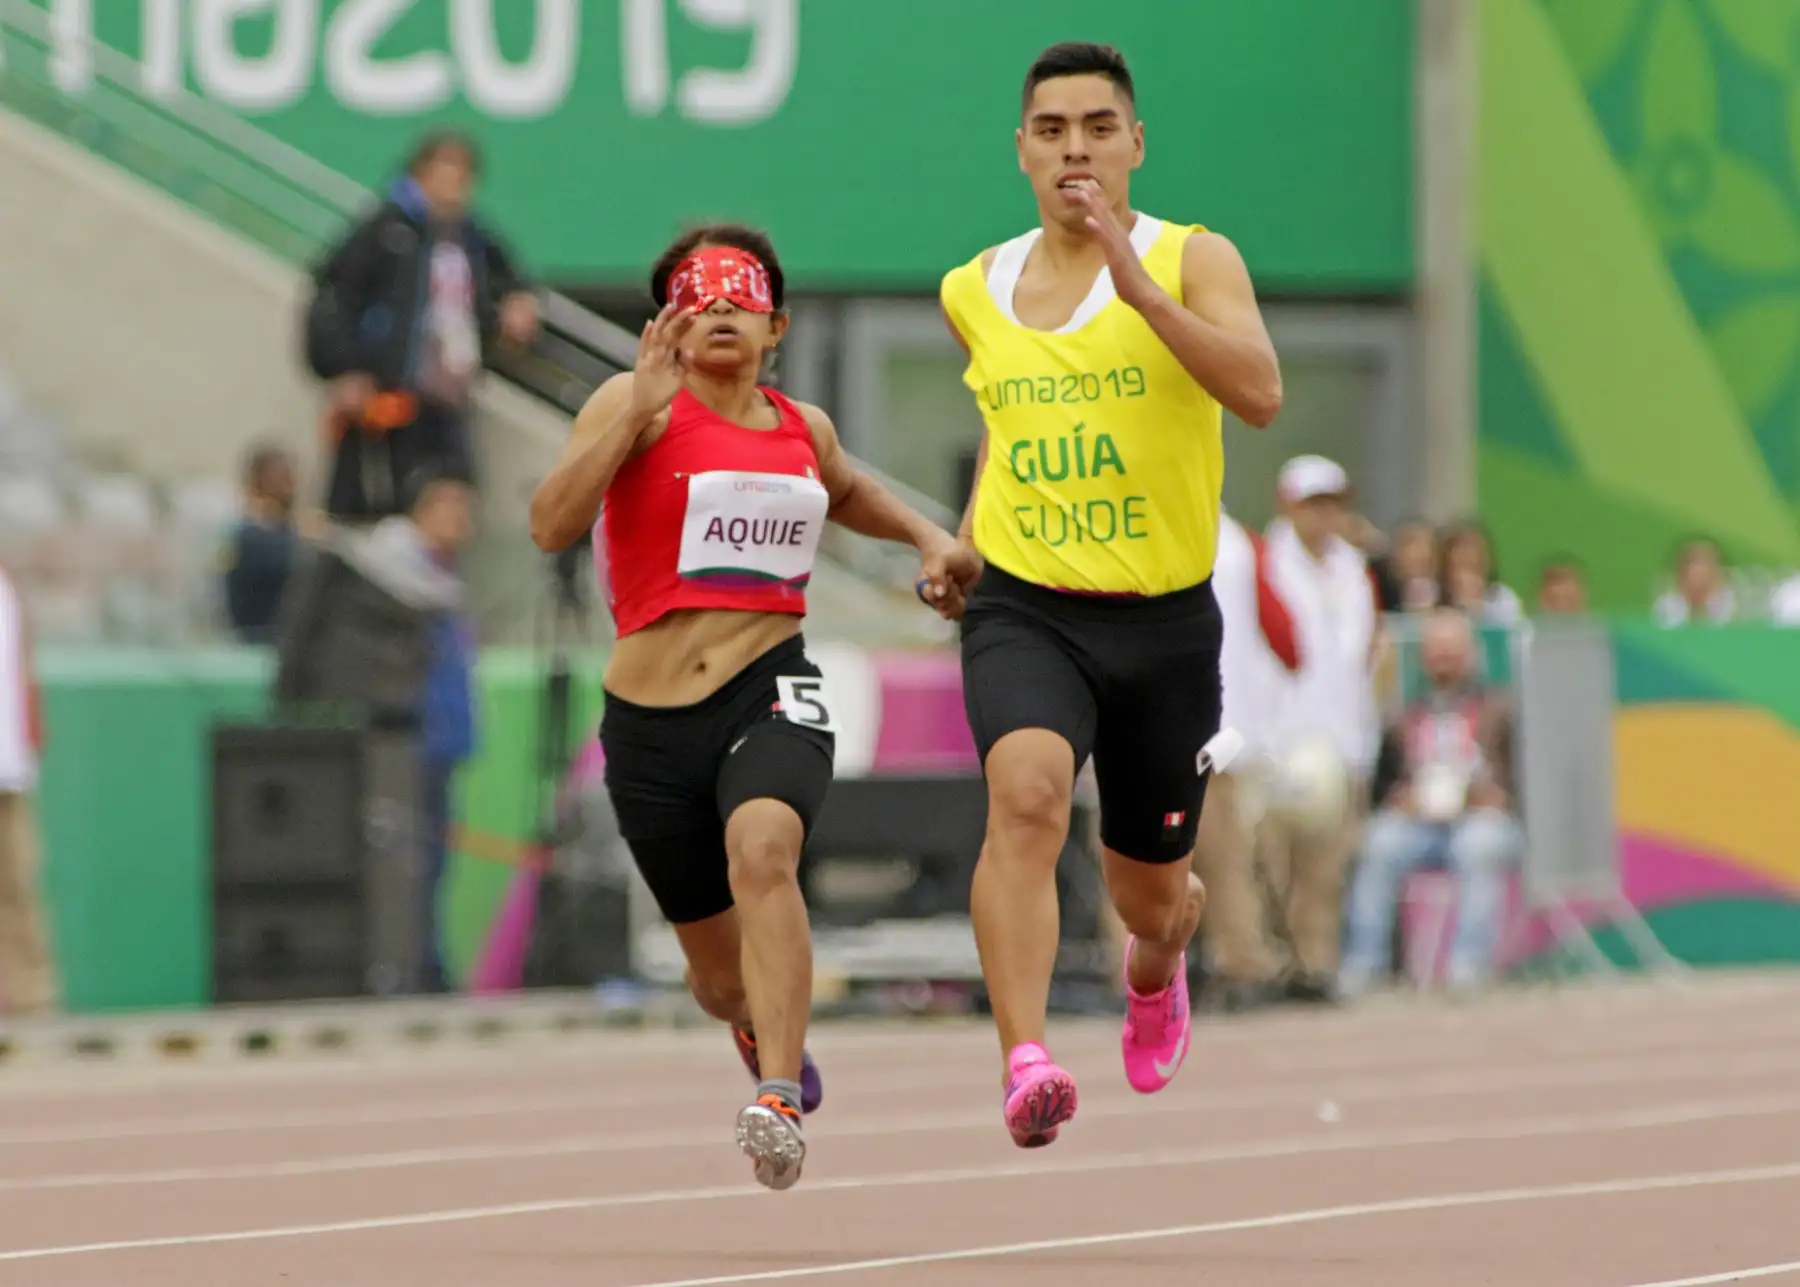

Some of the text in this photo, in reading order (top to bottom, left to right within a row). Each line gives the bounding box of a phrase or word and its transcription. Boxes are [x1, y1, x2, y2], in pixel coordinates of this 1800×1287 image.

[1010, 421, 1126, 484] GUÍA
[704, 516, 807, 552] AQUIJE
[1014, 496, 1148, 546] GUIDE
[791, 682, 830, 725] 5
